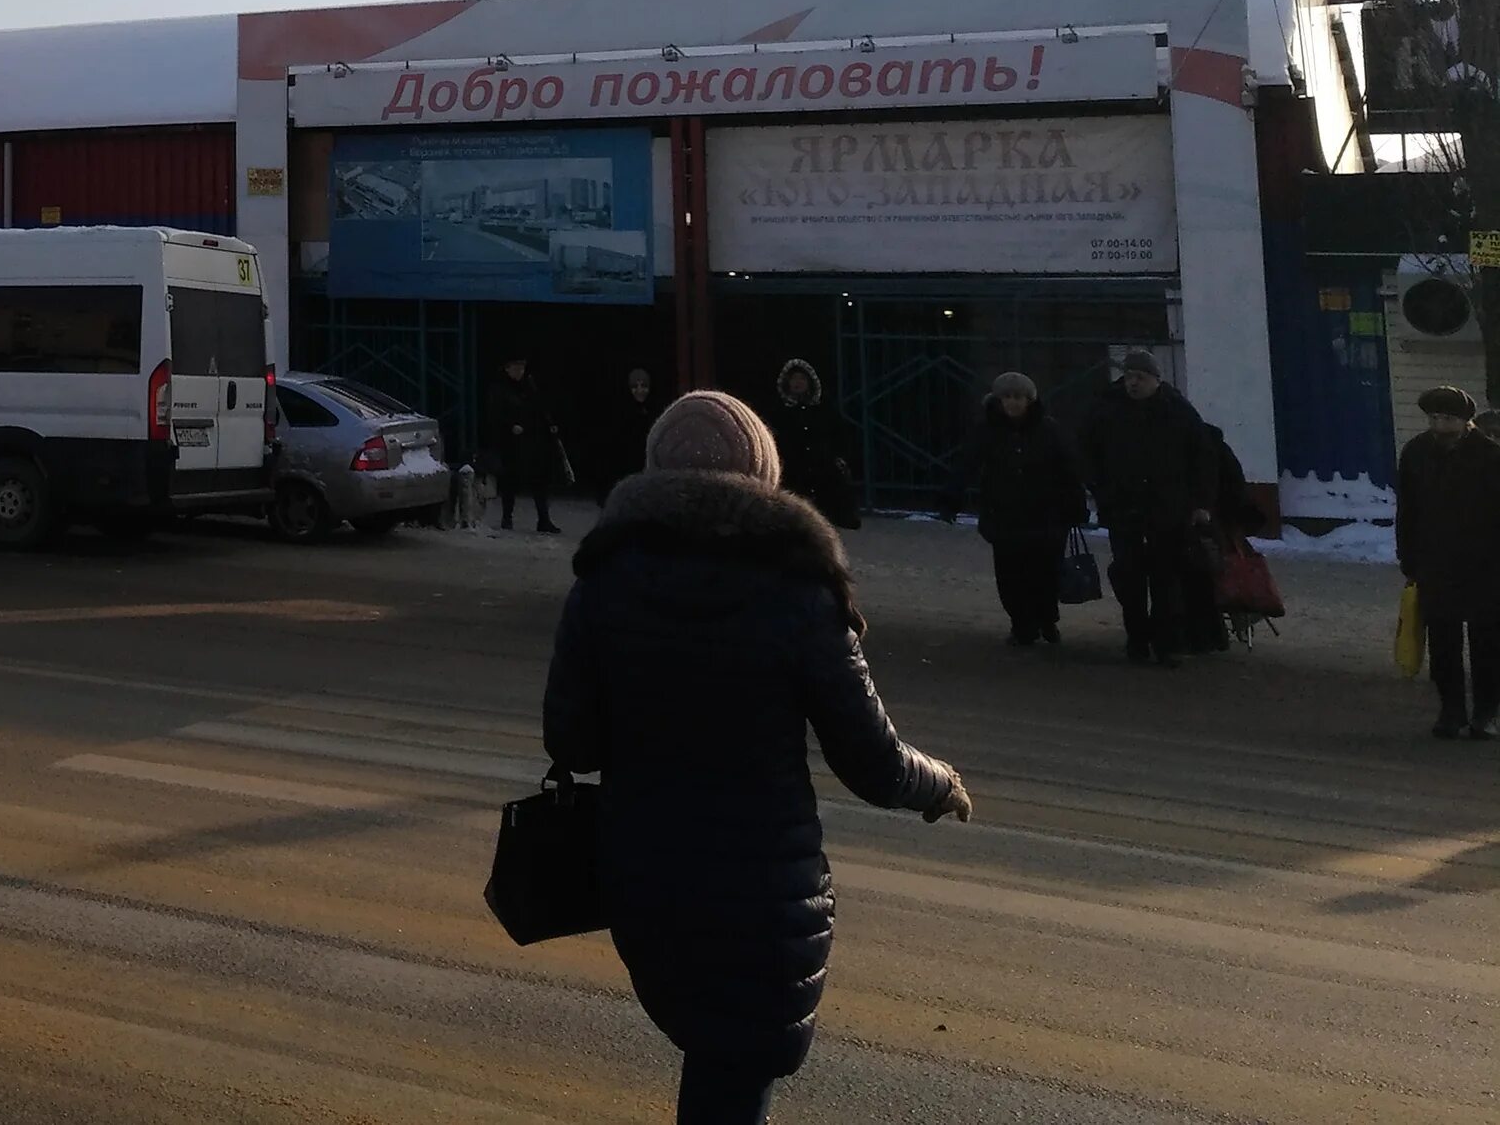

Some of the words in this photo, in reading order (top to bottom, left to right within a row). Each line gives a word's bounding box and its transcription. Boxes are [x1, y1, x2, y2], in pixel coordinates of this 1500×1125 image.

[381, 67, 564, 121] Добро
[590, 45, 1045, 107] пожаловать!
[790, 129, 1077, 173] ЯРМАРКА
[738, 172, 1143, 209] «ЮГО-ЗАПАДНАЯ»
[238, 259, 250, 281] 37
